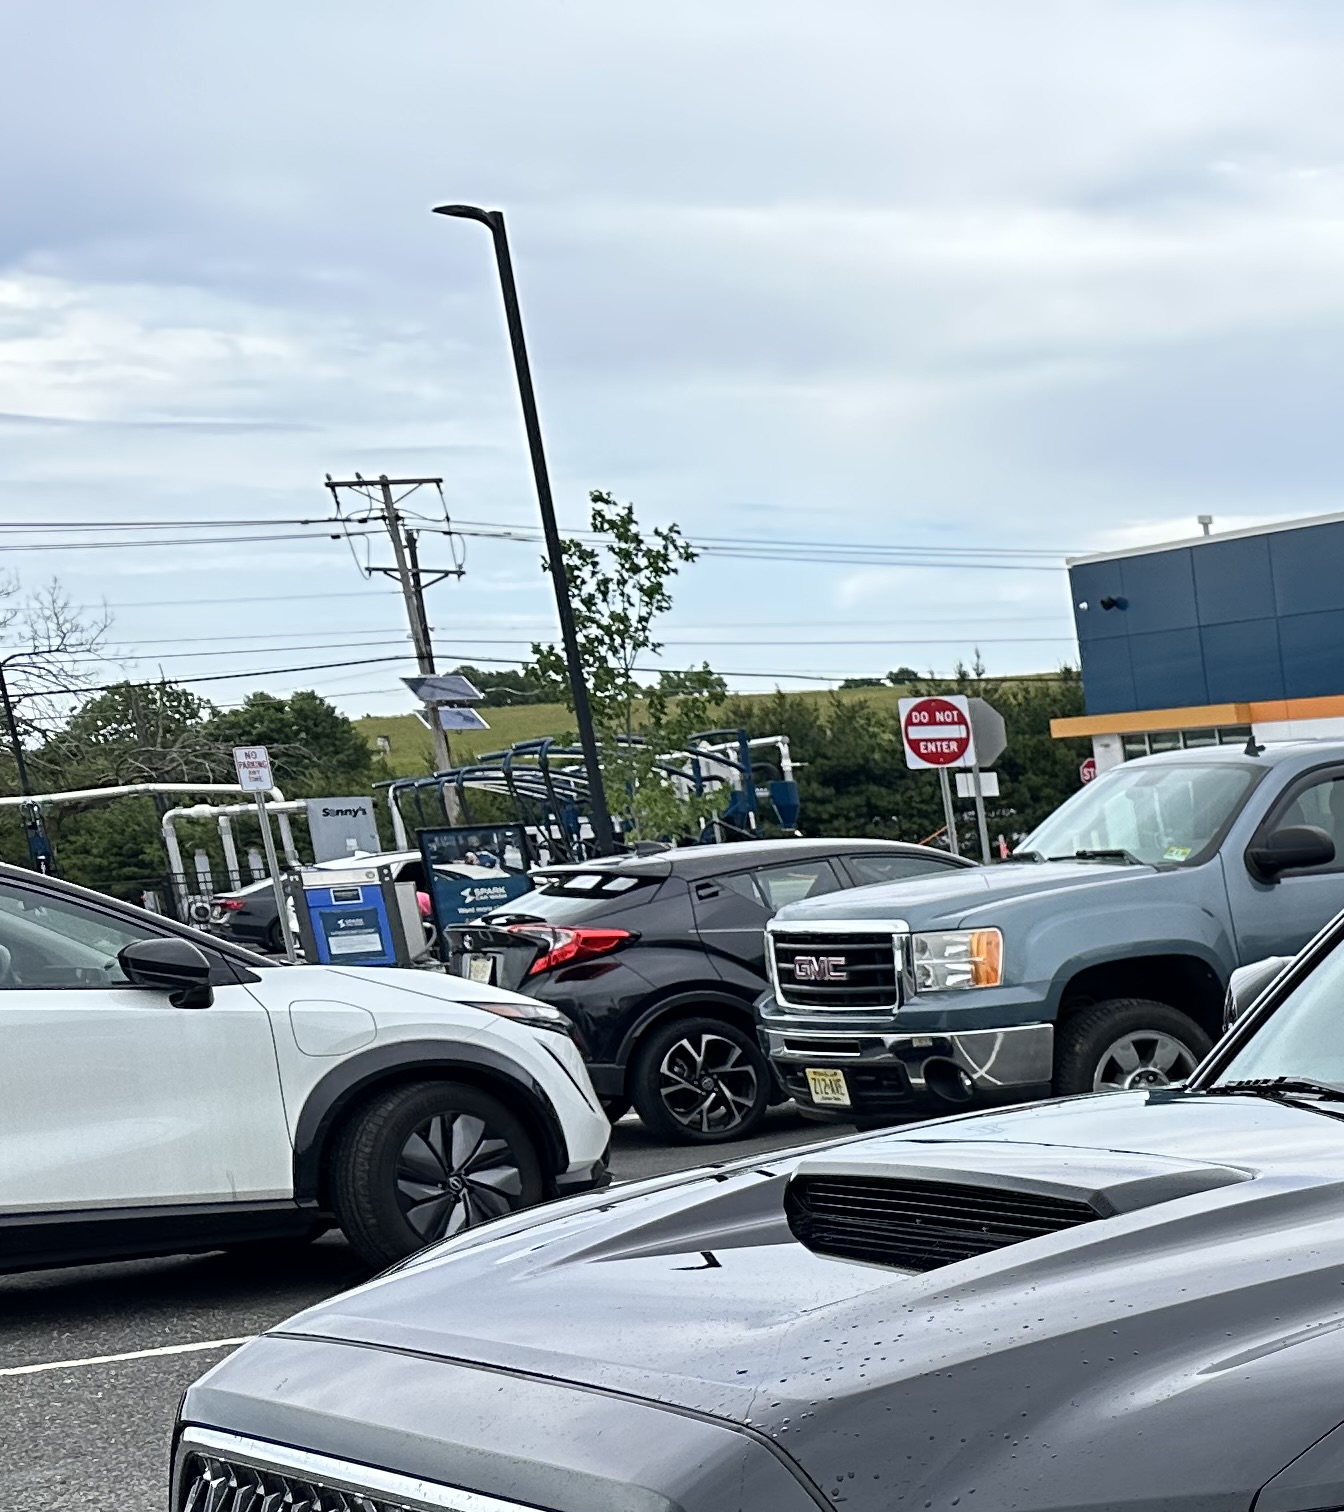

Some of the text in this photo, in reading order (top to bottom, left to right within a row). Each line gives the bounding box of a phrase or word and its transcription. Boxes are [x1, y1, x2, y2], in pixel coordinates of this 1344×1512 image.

[911, 710, 959, 724] DO NOT
[919, 741, 959, 754] ENTER
[244, 750, 258, 760] NO
[237, 761, 268, 769] PARKING
[322, 806, 368, 818] Sonny's
[473, 886, 507, 897] SPARK
[794, 956, 848, 981] GMC
